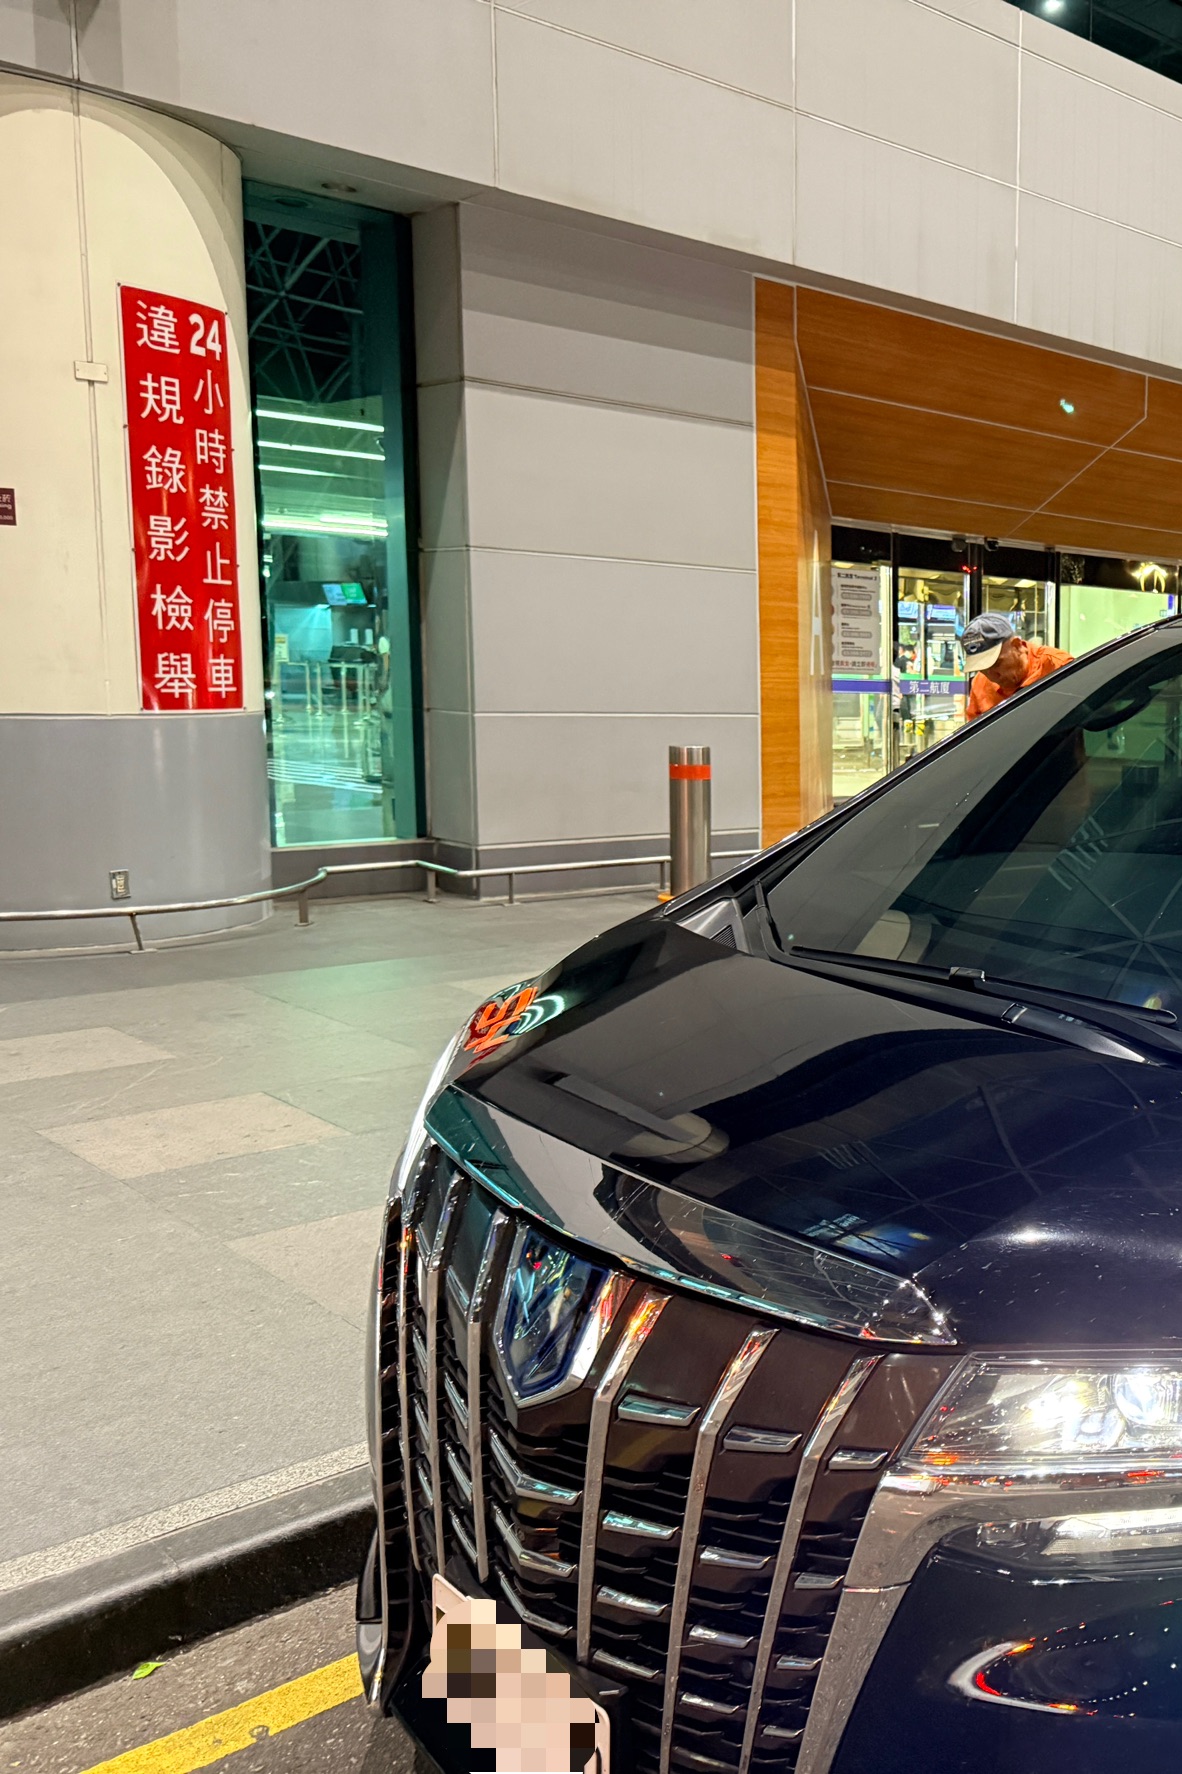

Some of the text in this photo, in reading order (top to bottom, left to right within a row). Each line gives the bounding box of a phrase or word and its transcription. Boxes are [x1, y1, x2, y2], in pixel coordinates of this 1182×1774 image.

[135, 299, 197, 699] 違規錄影檢舉
[188, 312, 238, 699] 24小時禁止停車
[909, 681, 950, 695] 第二航廈
